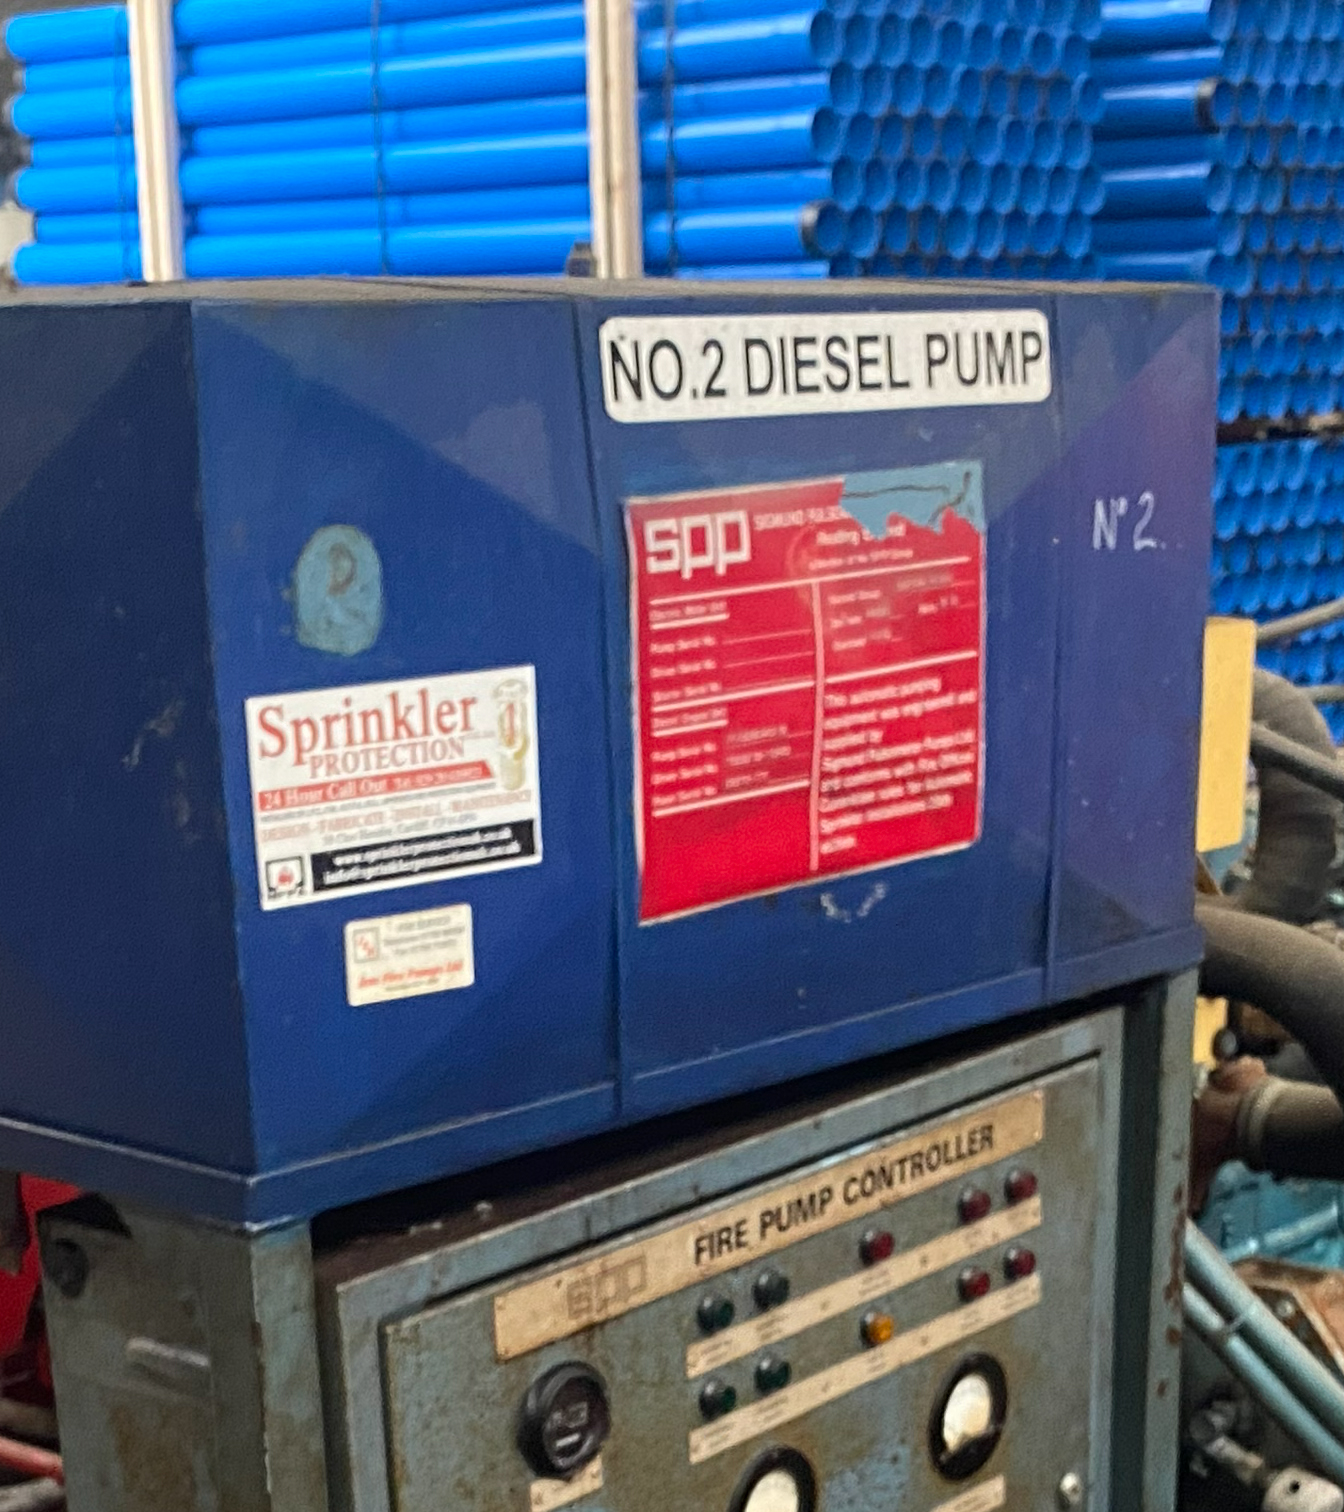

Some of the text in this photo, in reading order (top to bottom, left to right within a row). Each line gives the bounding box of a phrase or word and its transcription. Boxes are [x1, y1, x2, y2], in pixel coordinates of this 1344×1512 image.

[610, 330, 1044, 400] NO.2 DIESEL PUMP
[257, 687, 478, 767] Sprinkler
[309, 736, 465, 779] PROTECTION
[263, 792, 281, 810] 24
[285, 787, 323, 807] Hour
[327, 782, 356, 802] Call
[360, 778, 388, 796] Out
[694, 1219, 749, 1266] FIRE
[759, 1187, 833, 1239] PUMP
[842, 1124, 995, 1204] CONTROLLER
